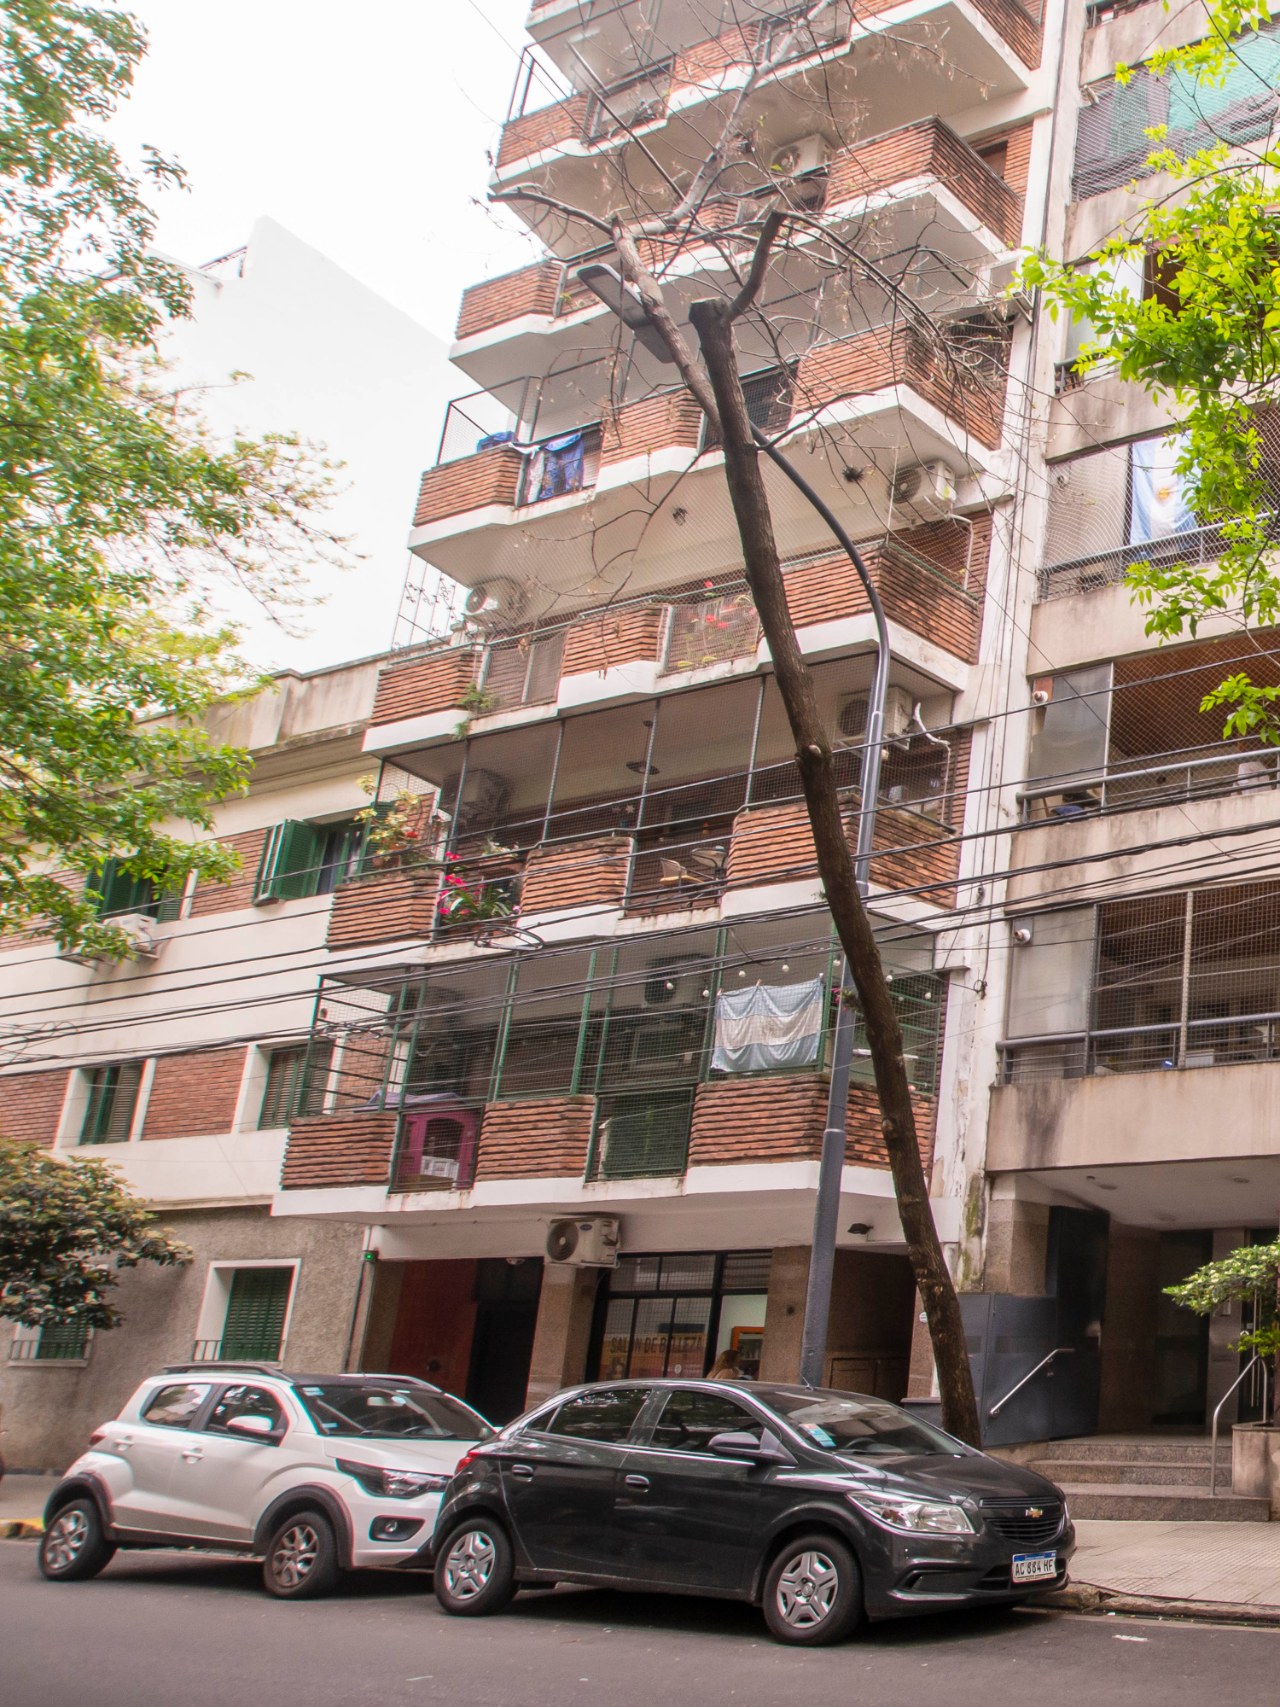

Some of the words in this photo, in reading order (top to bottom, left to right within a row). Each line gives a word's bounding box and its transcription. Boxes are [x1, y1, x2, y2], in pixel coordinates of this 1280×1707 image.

[610, 1337, 642, 1353] SALN
[644, 1337, 658, 1353] DE
[659, 1335, 703, 1353] BLLEZA
